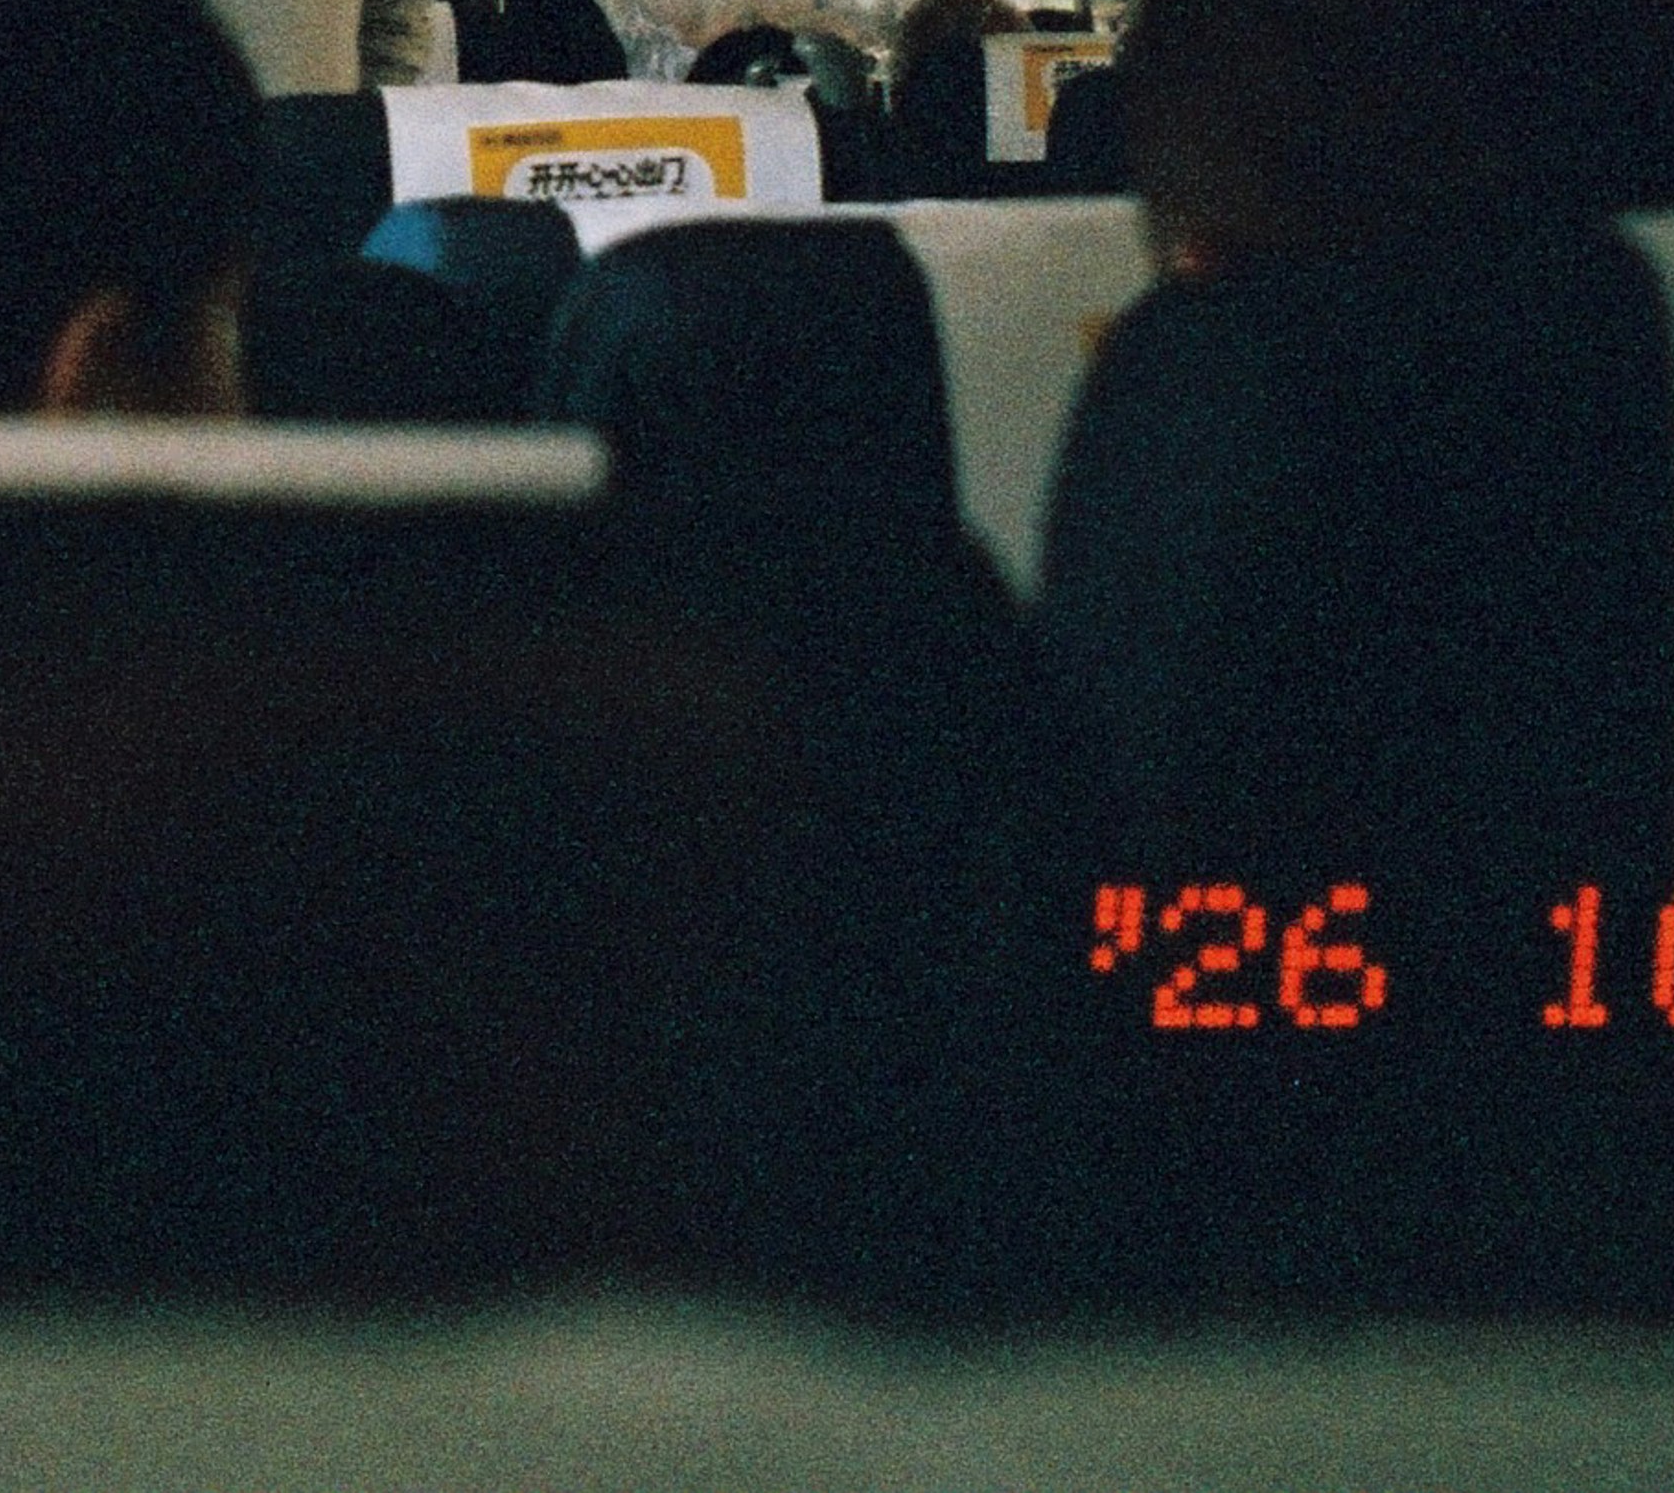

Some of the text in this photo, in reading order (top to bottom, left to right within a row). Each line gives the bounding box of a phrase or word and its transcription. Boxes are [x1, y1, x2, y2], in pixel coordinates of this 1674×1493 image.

[528, 156, 686, 194] 开开心心出门
